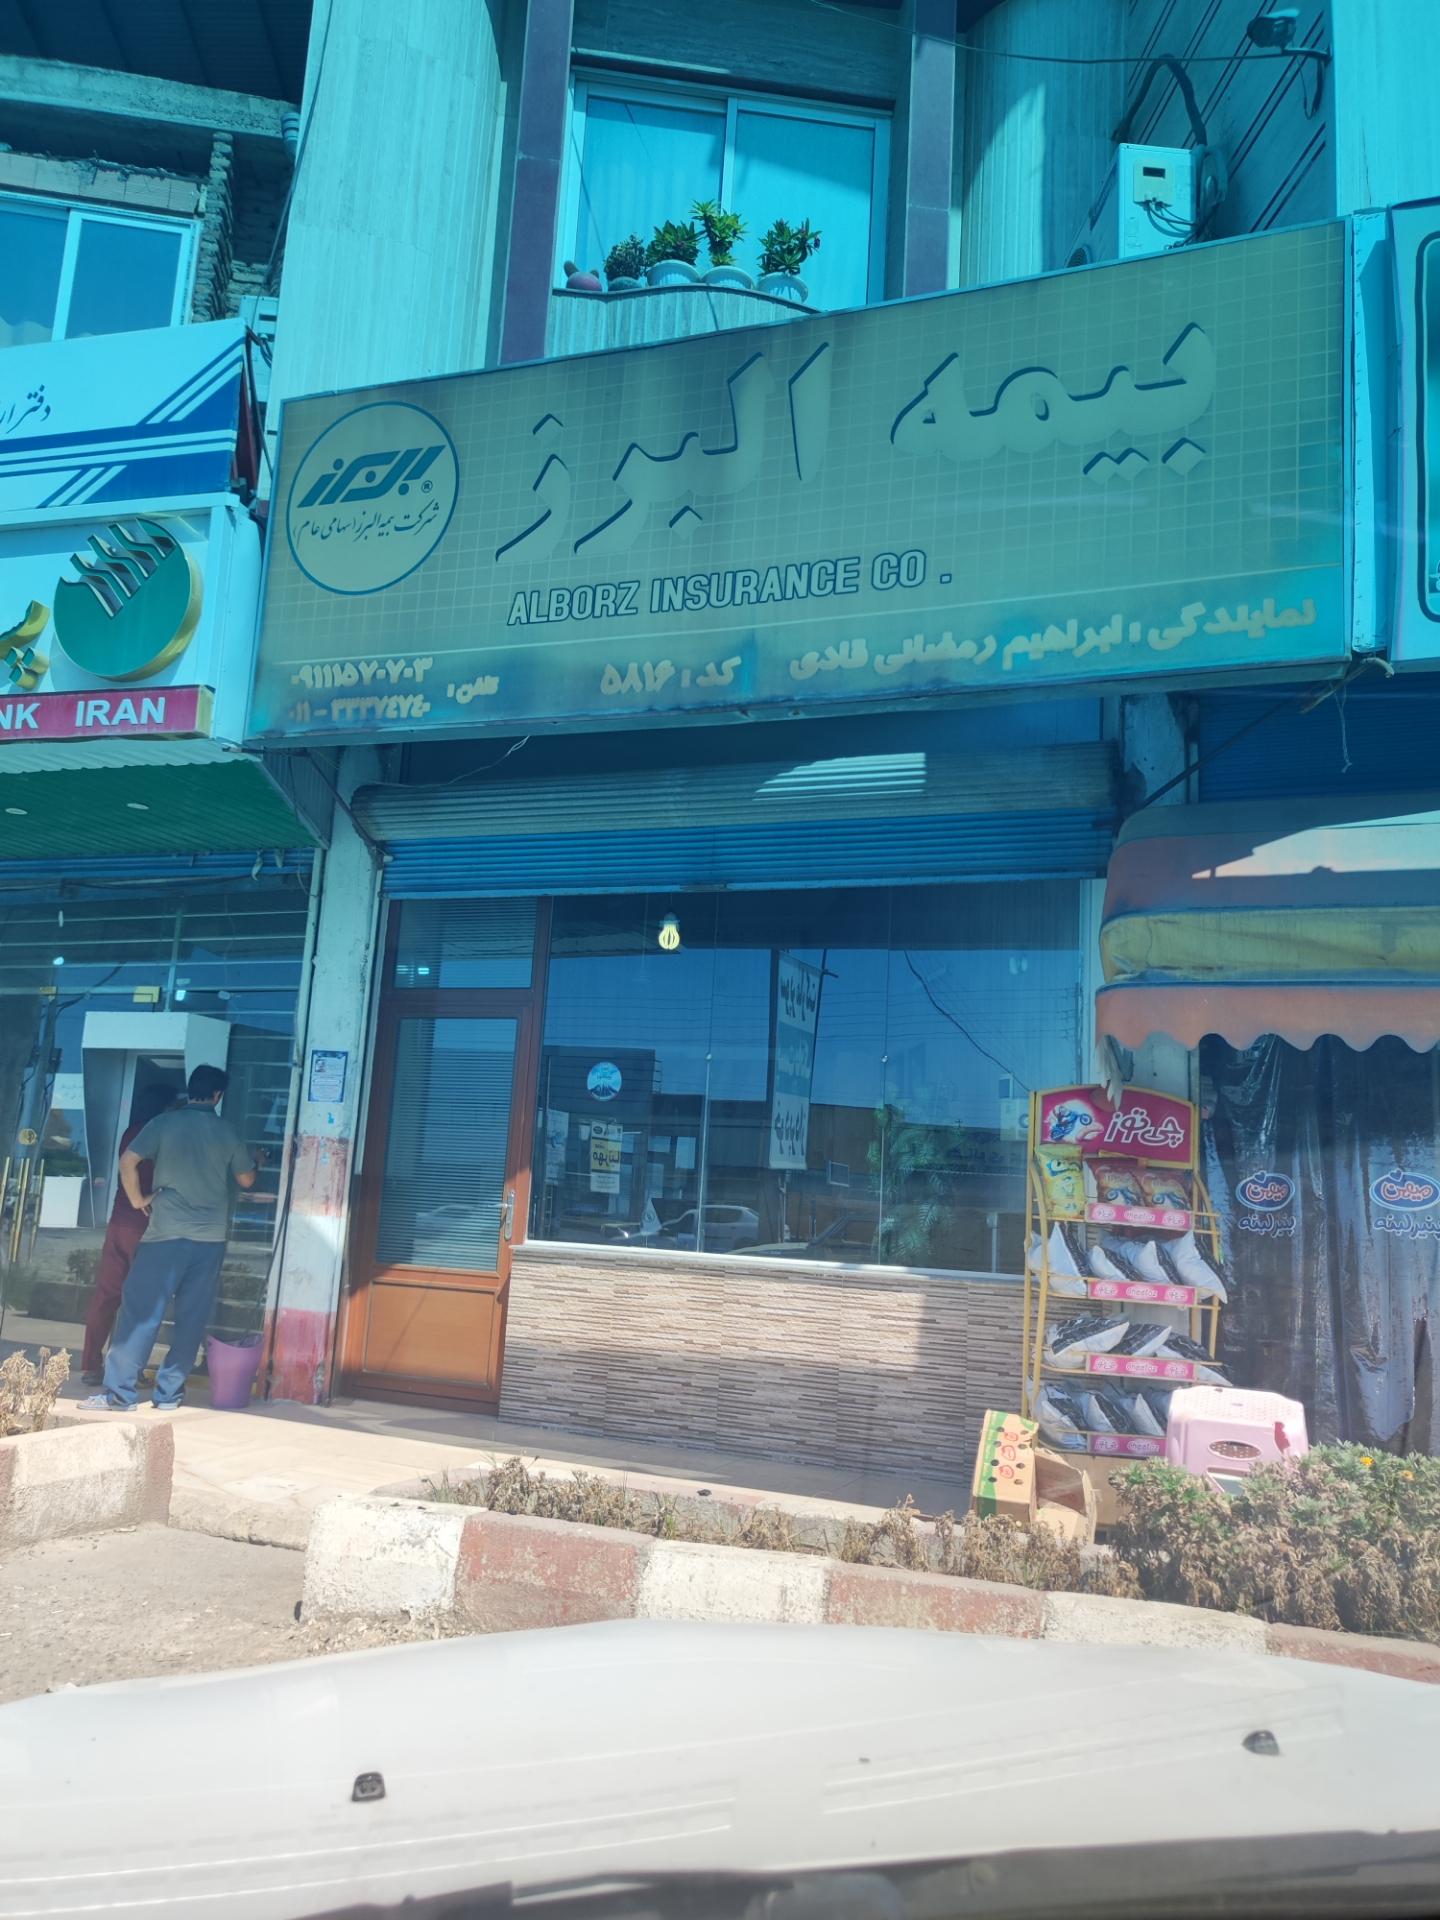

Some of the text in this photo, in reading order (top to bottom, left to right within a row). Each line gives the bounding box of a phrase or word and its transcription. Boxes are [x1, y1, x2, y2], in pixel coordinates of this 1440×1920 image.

[6, 384, 51, 434] دفتر
[495, 321, 1216, 561] بیمه البرز
[394, 498, 440, 536] شرکت
[507, 580, 641, 626] ALBORZ
[649, 556, 861, 613] INSURANCE
[75, 696, 167, 727] IRAN
